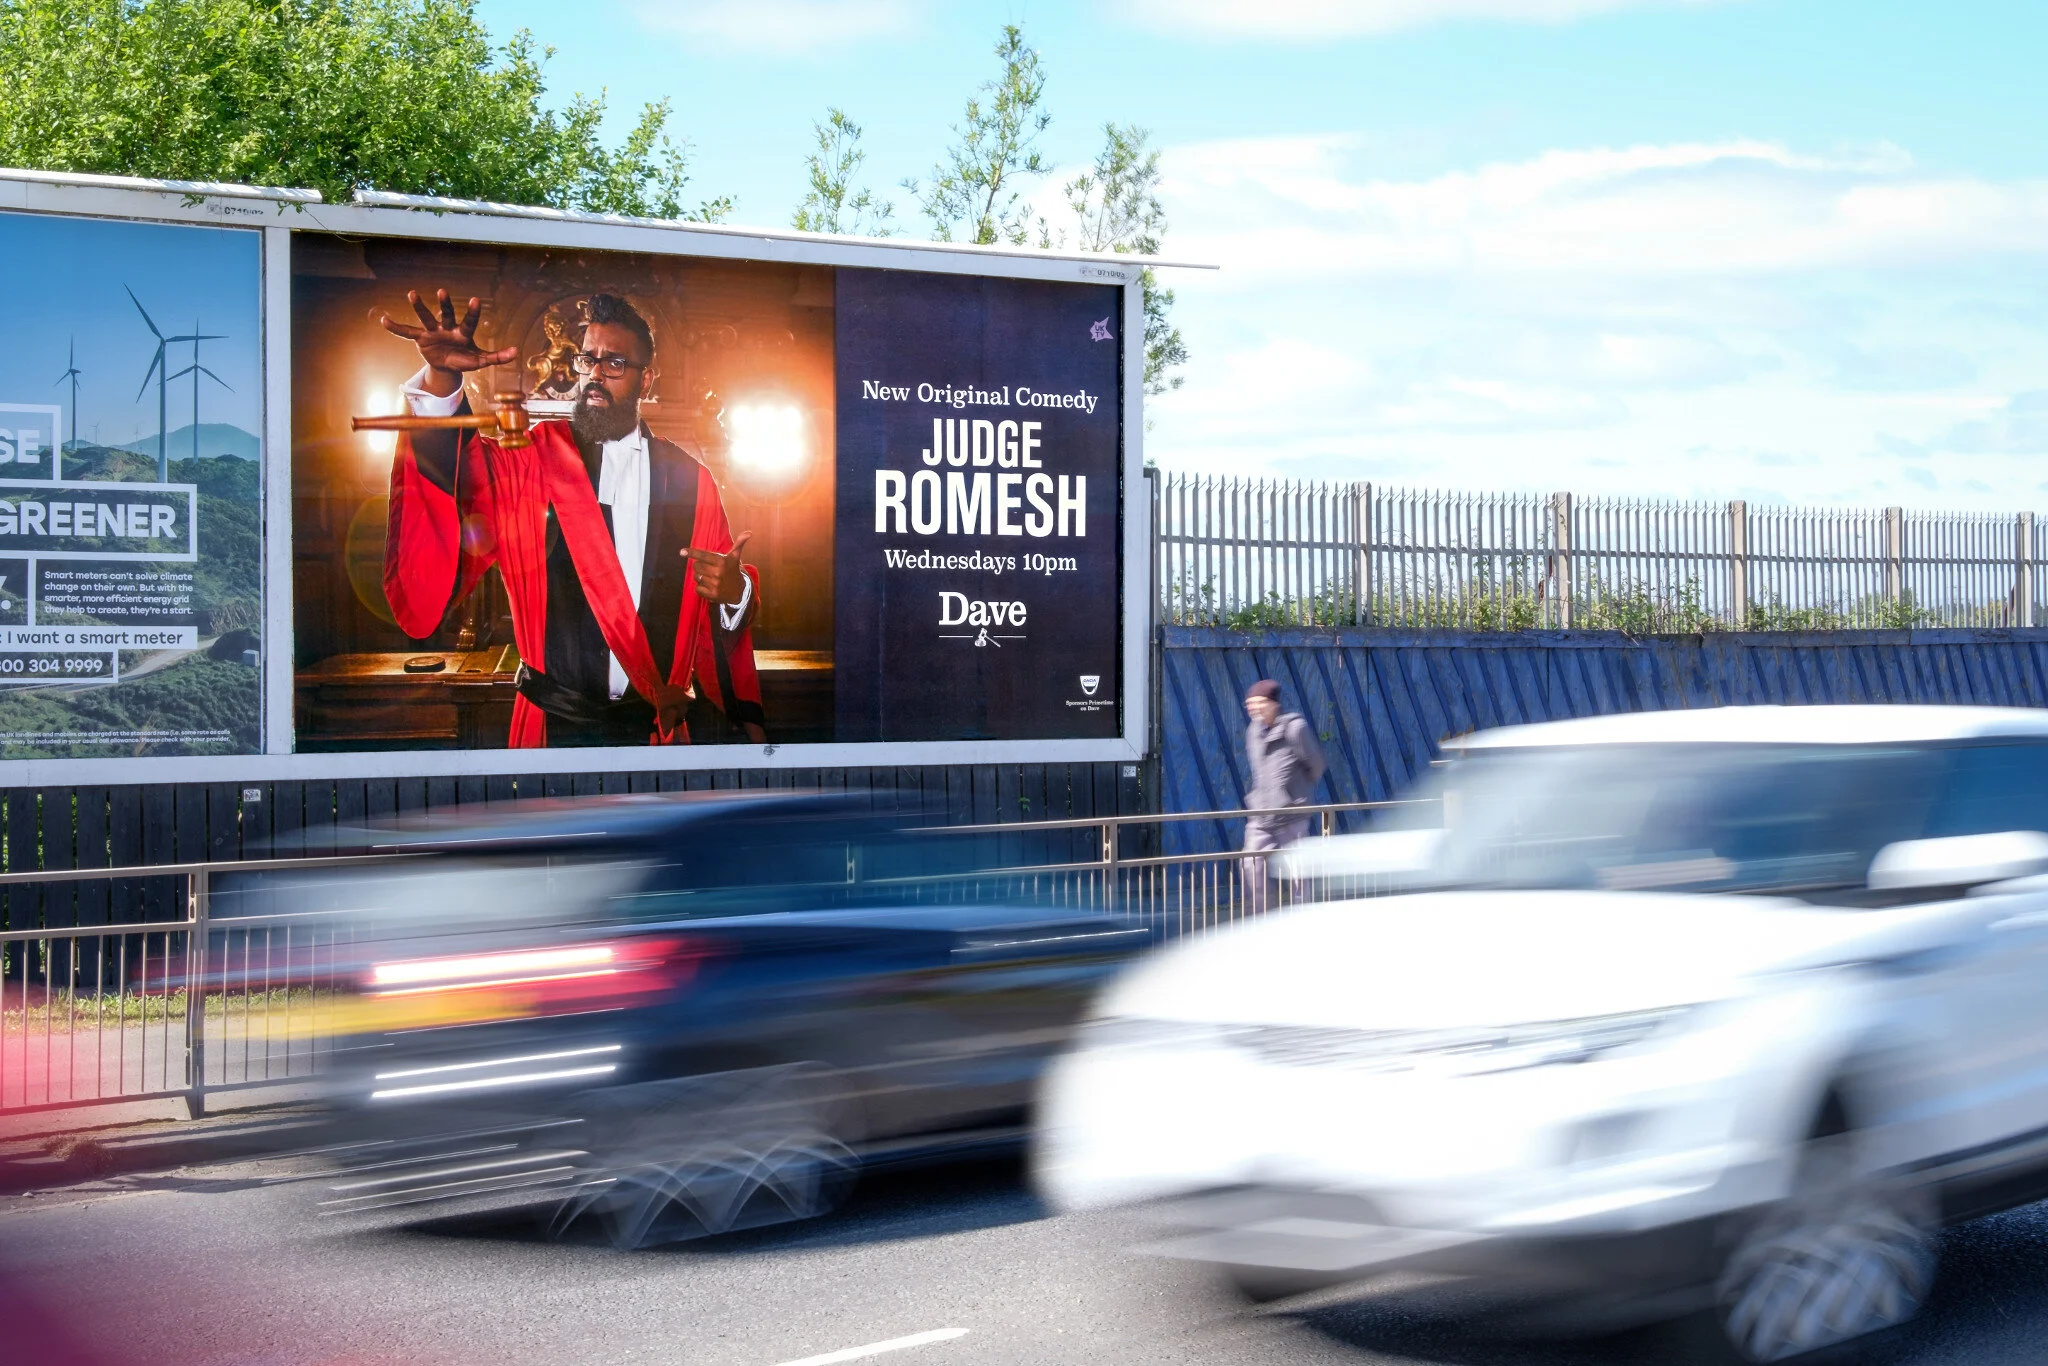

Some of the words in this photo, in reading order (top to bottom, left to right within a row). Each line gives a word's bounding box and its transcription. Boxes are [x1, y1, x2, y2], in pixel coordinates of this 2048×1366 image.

[862, 380, 910, 400] New
[917, 383, 1010, 408] Original
[1015, 387, 1098, 413] Comedy
[922, 418, 1042, 468] JUDGE
[875, 469, 1086, 537] ROMESH
[884, 549, 1016, 574] Wednesdays
[1022, 553, 1077, 576] 10pm
[44, 571, 73, 579] Smart
[75, 572, 107, 580] meters
[109, 572, 133, 580] can't
[135, 572, 158, 580] solve
[160, 572, 193, 581] climate
[44, 582, 78, 593] change
[93, 583, 115, 591] their
[157, 584, 176, 592] with
[178, 584, 193, 592] the
[44, 595, 81, 603] smarter,
[82, 595, 105, 603] more
[106, 594, 142, 603] efficient
[143, 596, 172, 605] energy
[173, 595, 190, 605] grid
[44, 605, 65, 615] they
[66, 606, 85, 615] help
[86, 606, 96, 614] to
[97, 607, 129, 615] create,
[130, 606, 160, 616] they're
[938, 591, 1027, 626] Dave
[8, 631, 11, 643] I
[17, 631, 59, 644] want
[64, 634, 74, 644] a
[80, 632, 128, 644] smart
[134, 632, 183, 644] meter
[0, 659, 24, 673] 00
[28, 659, 60, 673] 304
[64, 659, 103, 673] 9999
